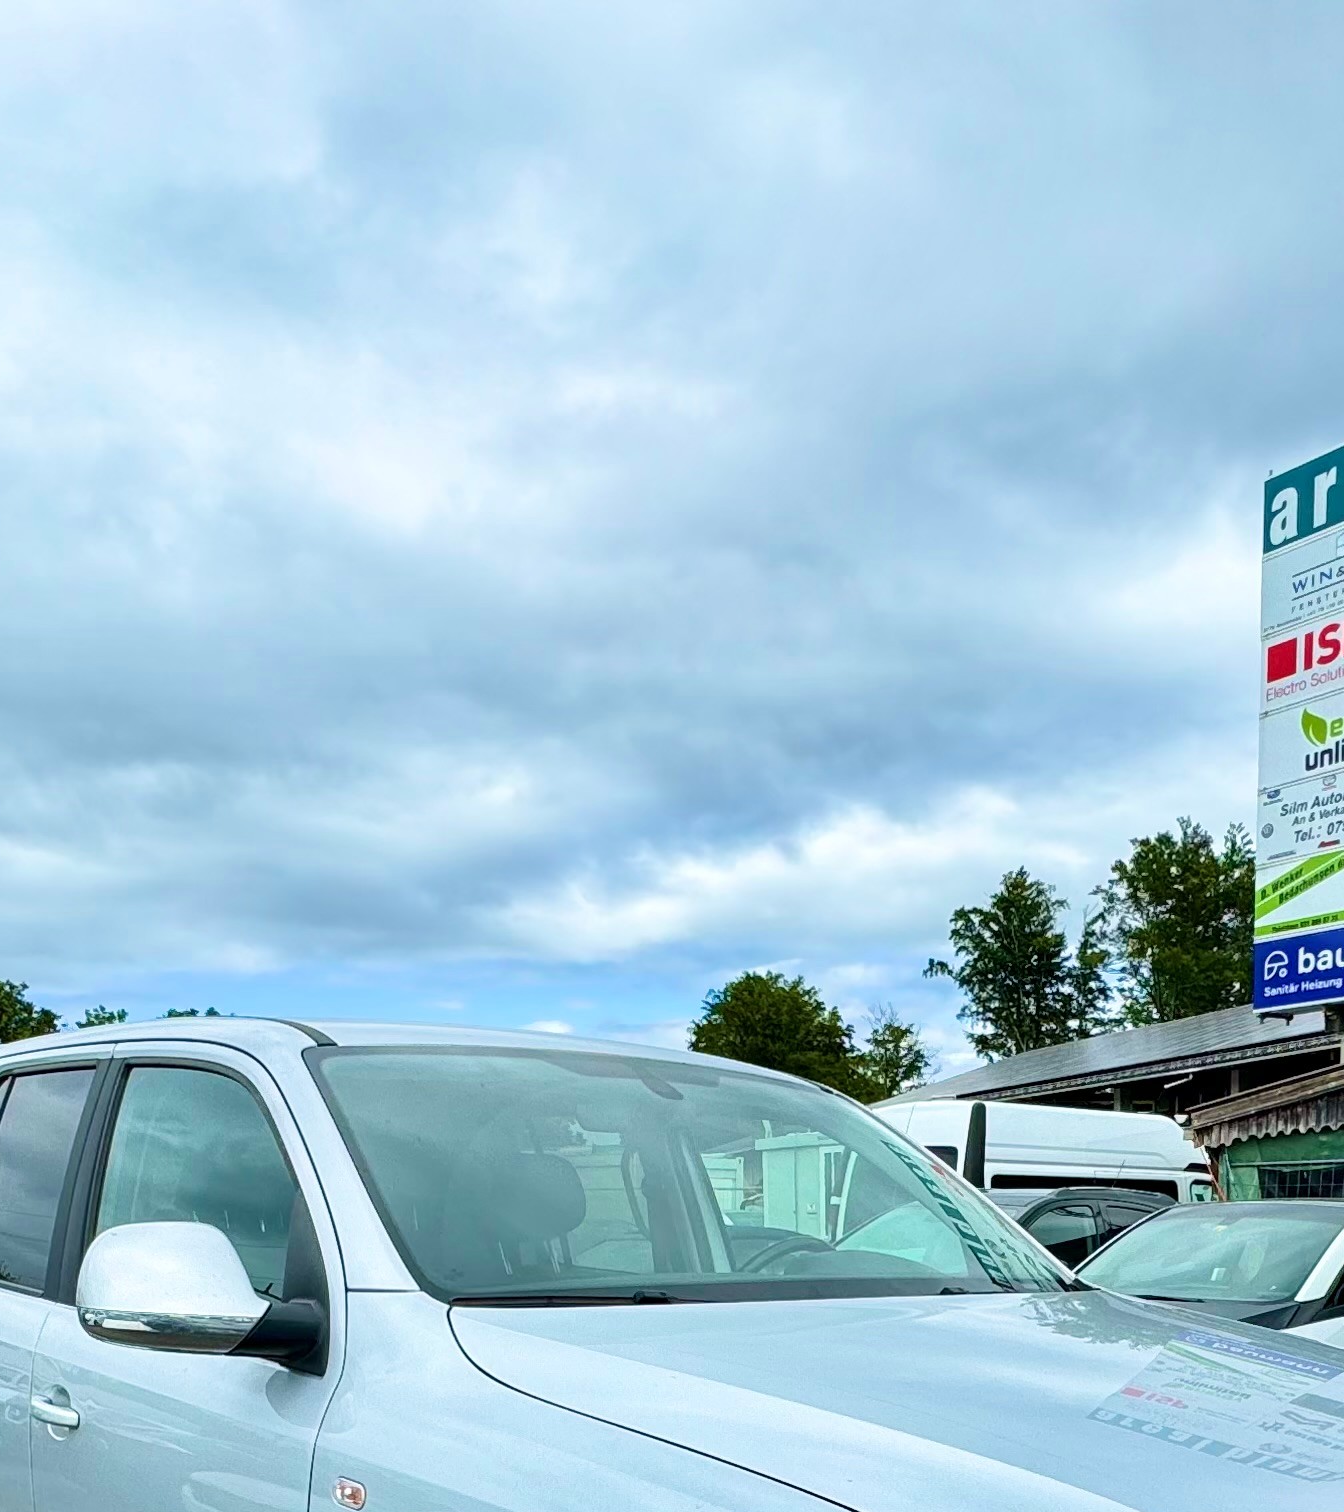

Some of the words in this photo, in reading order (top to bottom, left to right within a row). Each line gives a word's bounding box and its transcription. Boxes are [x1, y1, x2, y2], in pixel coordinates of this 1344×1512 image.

[1266, 679, 1307, 703] Electro
[1291, 815, 1306, 827] An
[1264, 981, 1299, 998] Sanitär
[1303, 977, 1343, 991] Heizung
